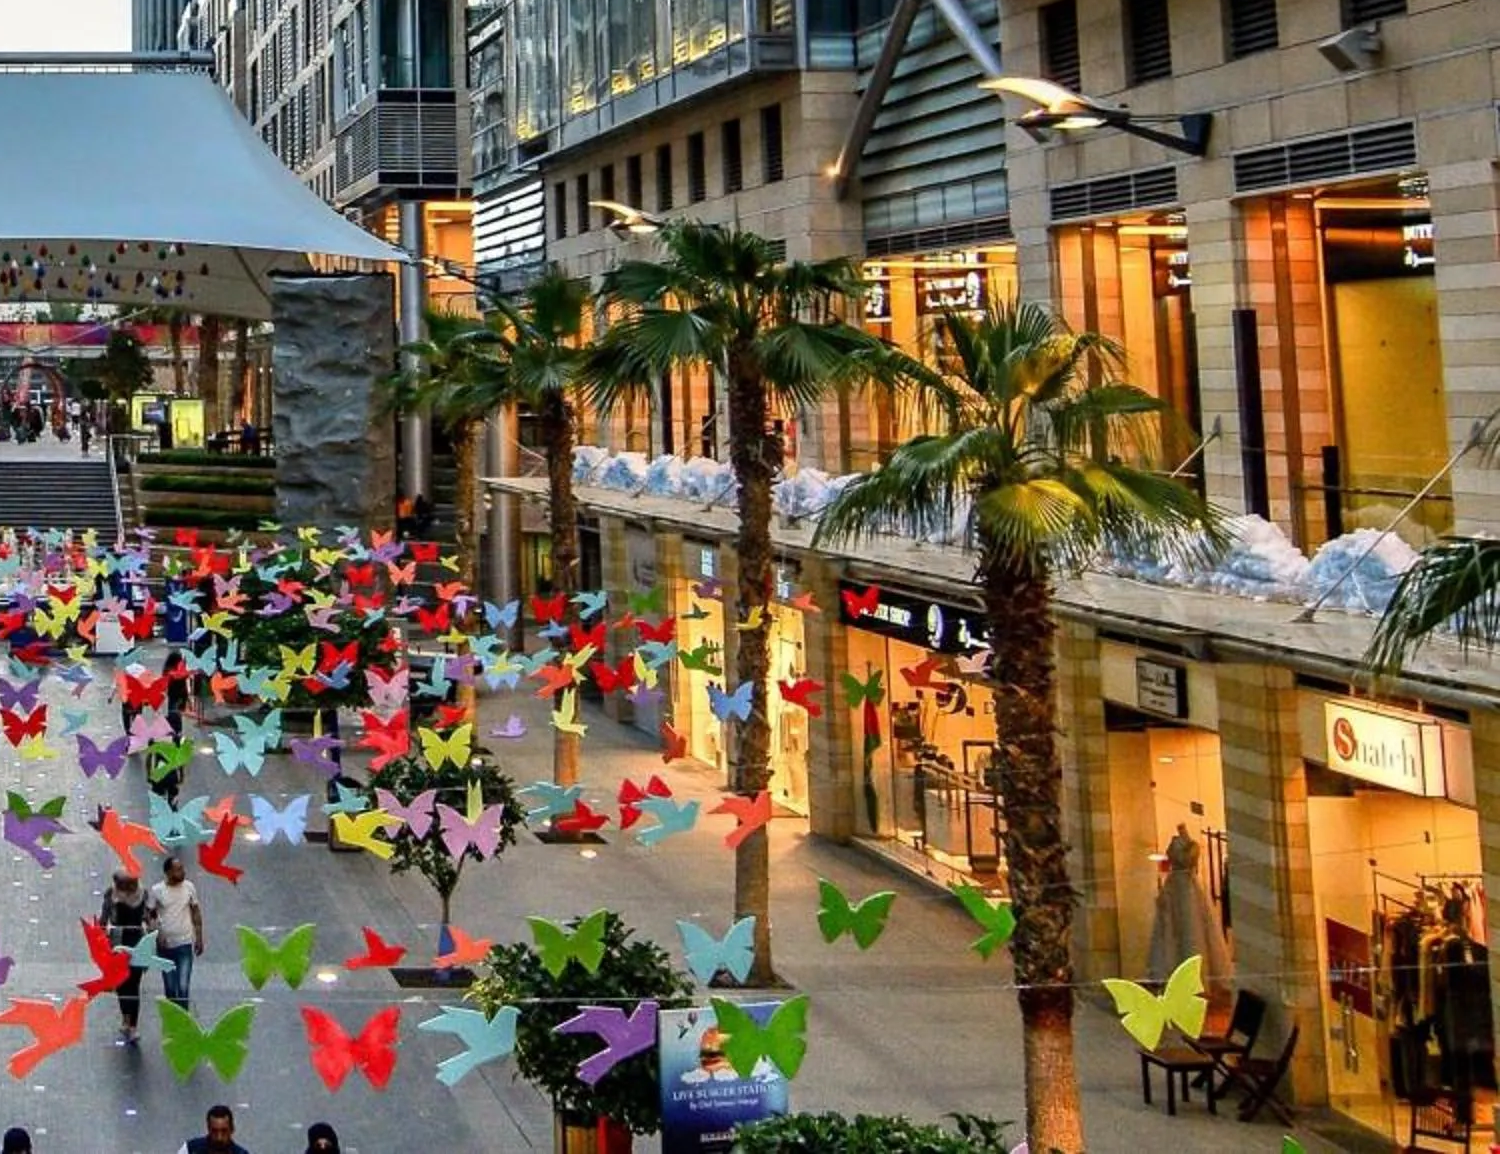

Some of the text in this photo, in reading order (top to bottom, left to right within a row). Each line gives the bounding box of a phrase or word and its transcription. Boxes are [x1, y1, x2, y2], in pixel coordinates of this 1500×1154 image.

[1333, 716, 1417, 778] Snatch
[672, 1089, 694, 1102] LIVE
[695, 1086, 737, 1100] BURGER
